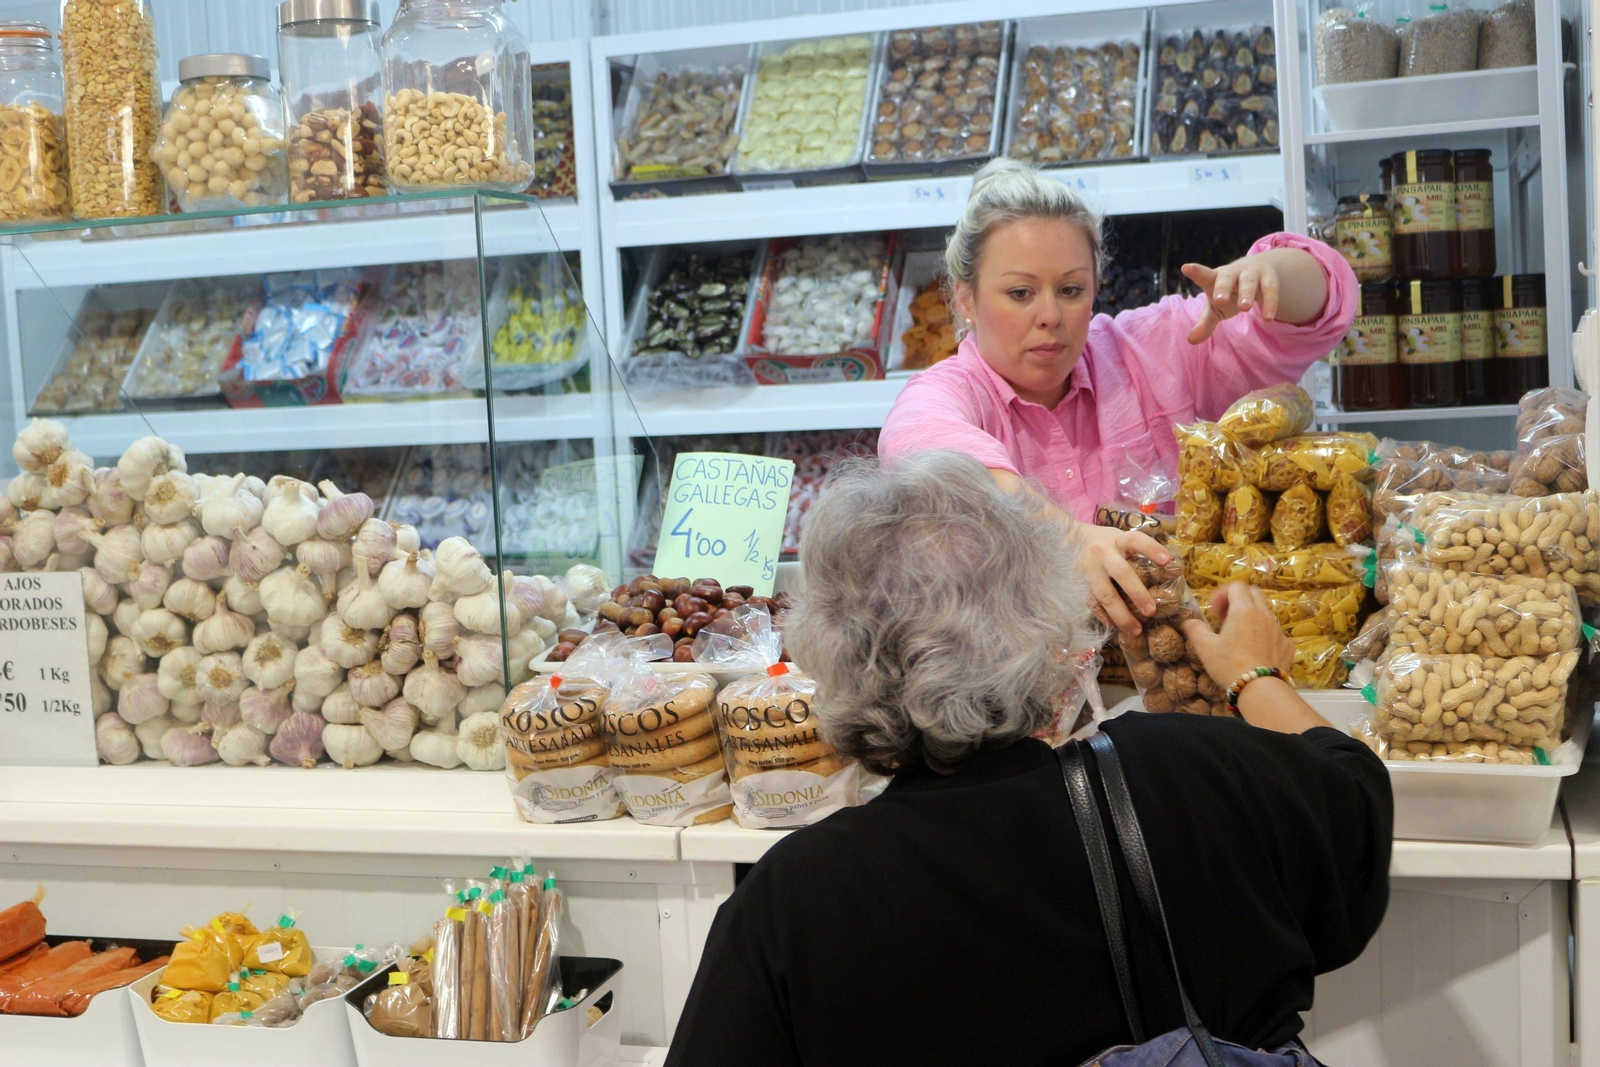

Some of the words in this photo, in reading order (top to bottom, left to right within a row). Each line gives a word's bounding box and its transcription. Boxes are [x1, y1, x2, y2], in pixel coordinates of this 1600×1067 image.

[1455, 183, 1480, 192] APAR
[1353, 317, 1386, 327] SAPAR
[1430, 325, 1447, 333] MIEL
[1463, 323, 1482, 331] MIEL
[1521, 319, 1540, 327] MIEL
[1369, 327, 1386, 335] MIEL
[676, 458, 789, 488] CASTAÑAS
[674, 483, 777, 510] GALLEGAS
[762, 556, 774, 580] Kg
[4, 577, 42, 591] AJOS
[50, 667, 70, 684] Kg
[43, 699, 81, 716] 1/2Kg
[503, 697, 597, 732] ROSCOS
[721, 699, 810, 731] ROSCO
[505, 721, 600, 753] ARTESANALE
[651, 804, 669, 813] panes
[674, 801, 690, 811] picos
